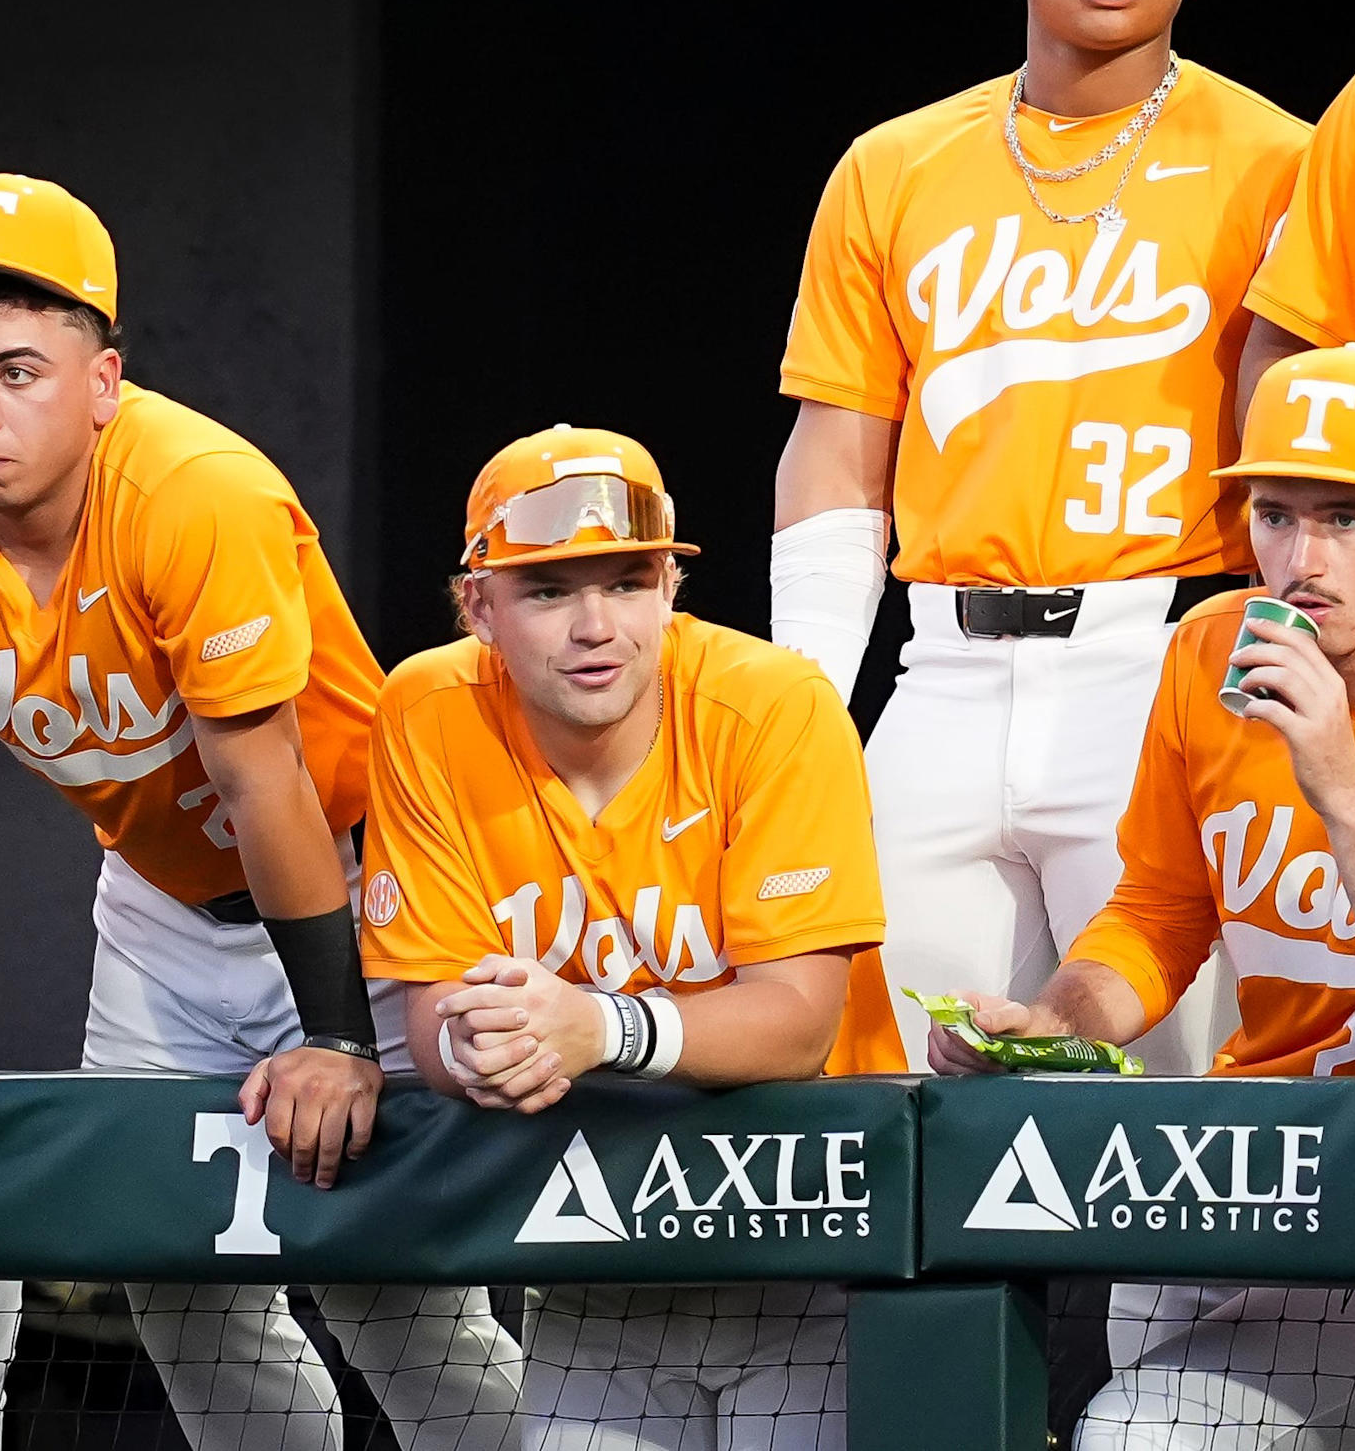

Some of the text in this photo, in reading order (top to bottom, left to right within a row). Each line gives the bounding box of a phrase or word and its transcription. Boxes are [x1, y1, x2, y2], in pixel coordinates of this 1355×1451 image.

[907, 215, 1195, 360] Vols
[1063, 419, 1192, 538] 32
[491, 874, 729, 992] Vols
[192, 1112, 282, 1255] T
[631, 1131, 871, 1211] AXLE
[1083, 1122, 1324, 1204] AXLE
[633, 1211, 871, 1240] LOGISTICS
[1087, 1204, 1321, 1234] LOGISTICS
